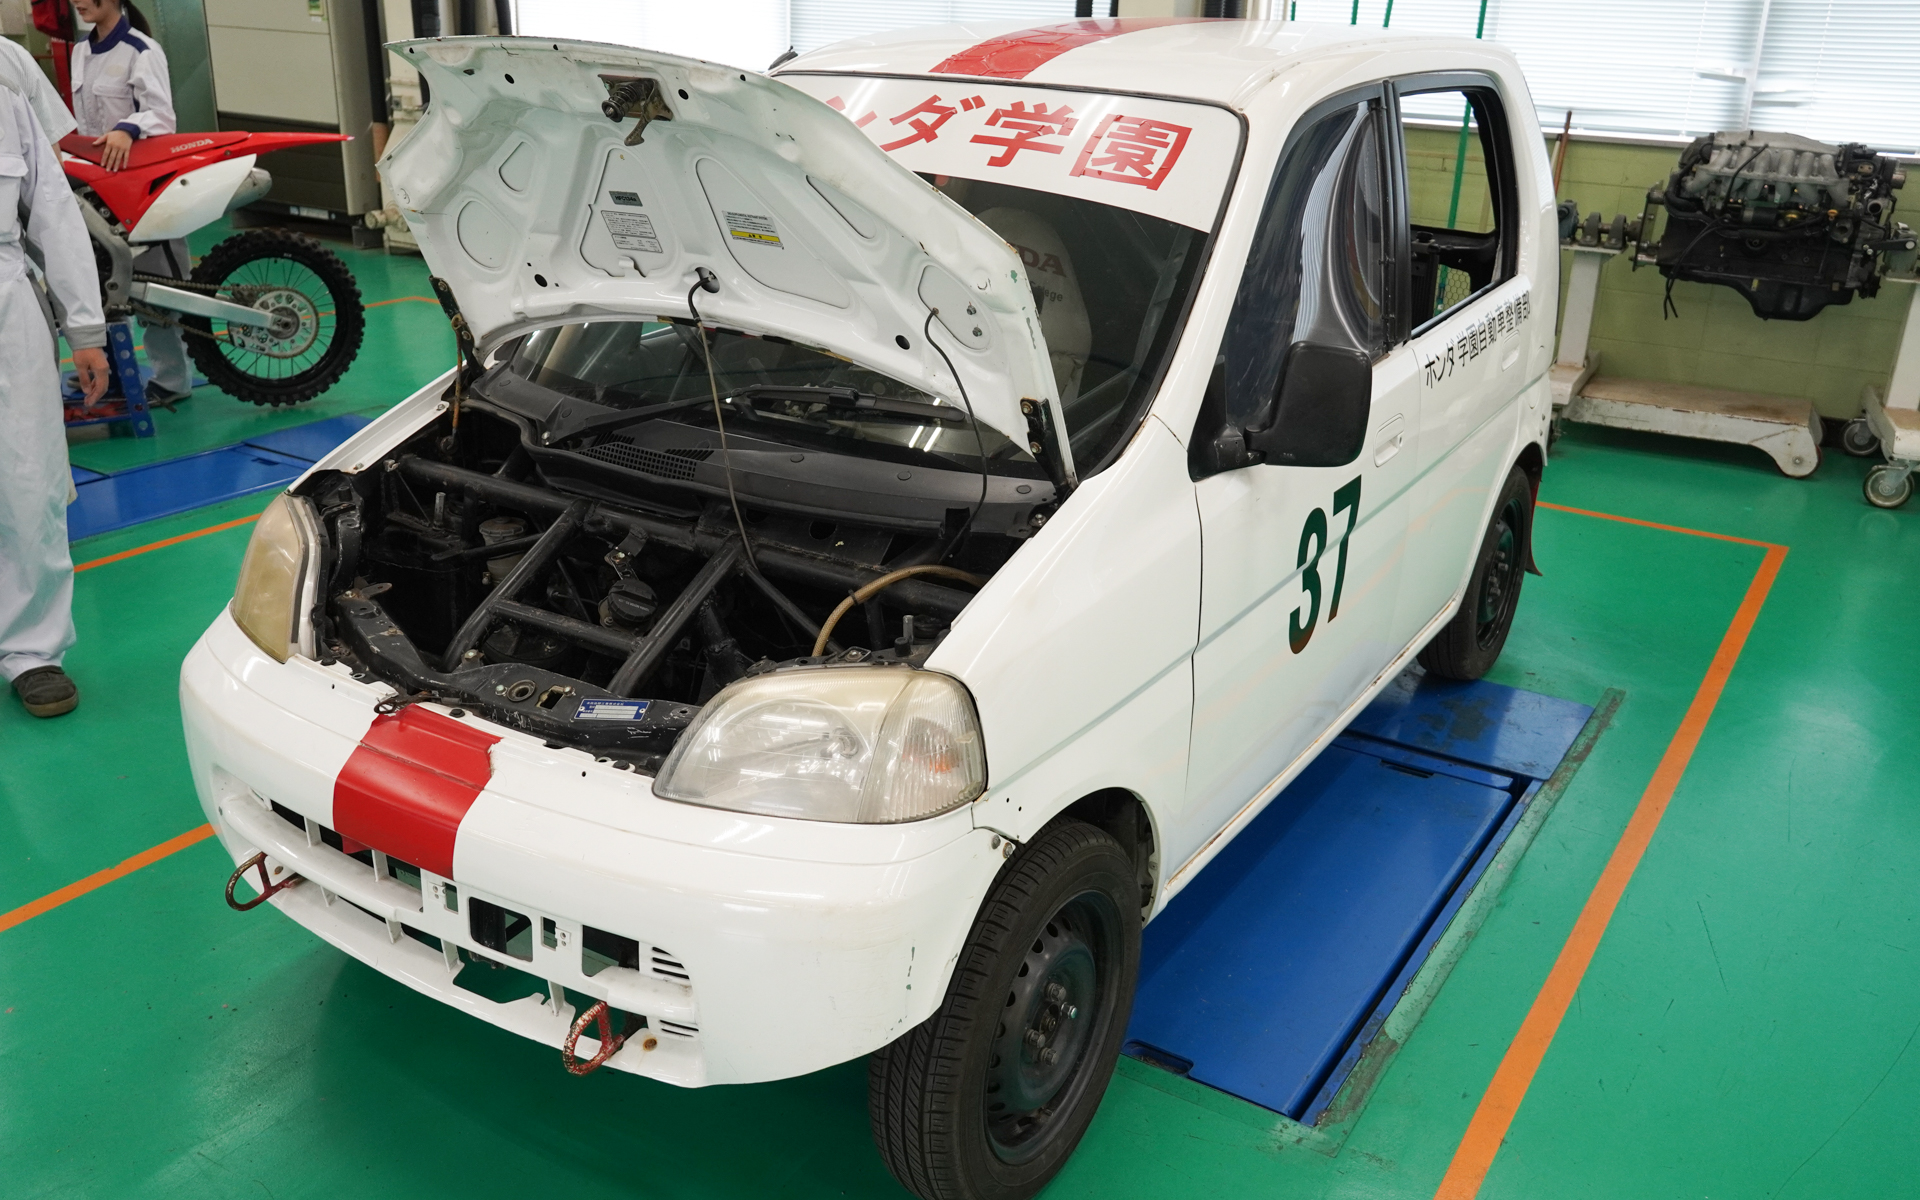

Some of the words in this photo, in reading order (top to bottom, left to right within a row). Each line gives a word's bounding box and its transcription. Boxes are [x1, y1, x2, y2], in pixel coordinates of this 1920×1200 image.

[170, 138, 214, 153] HONDA
[1012, 243, 1067, 278] DA
[1425, 289, 1531, 389] ホンダ学園自動車整備部
[1289, 474, 1362, 655] 37
